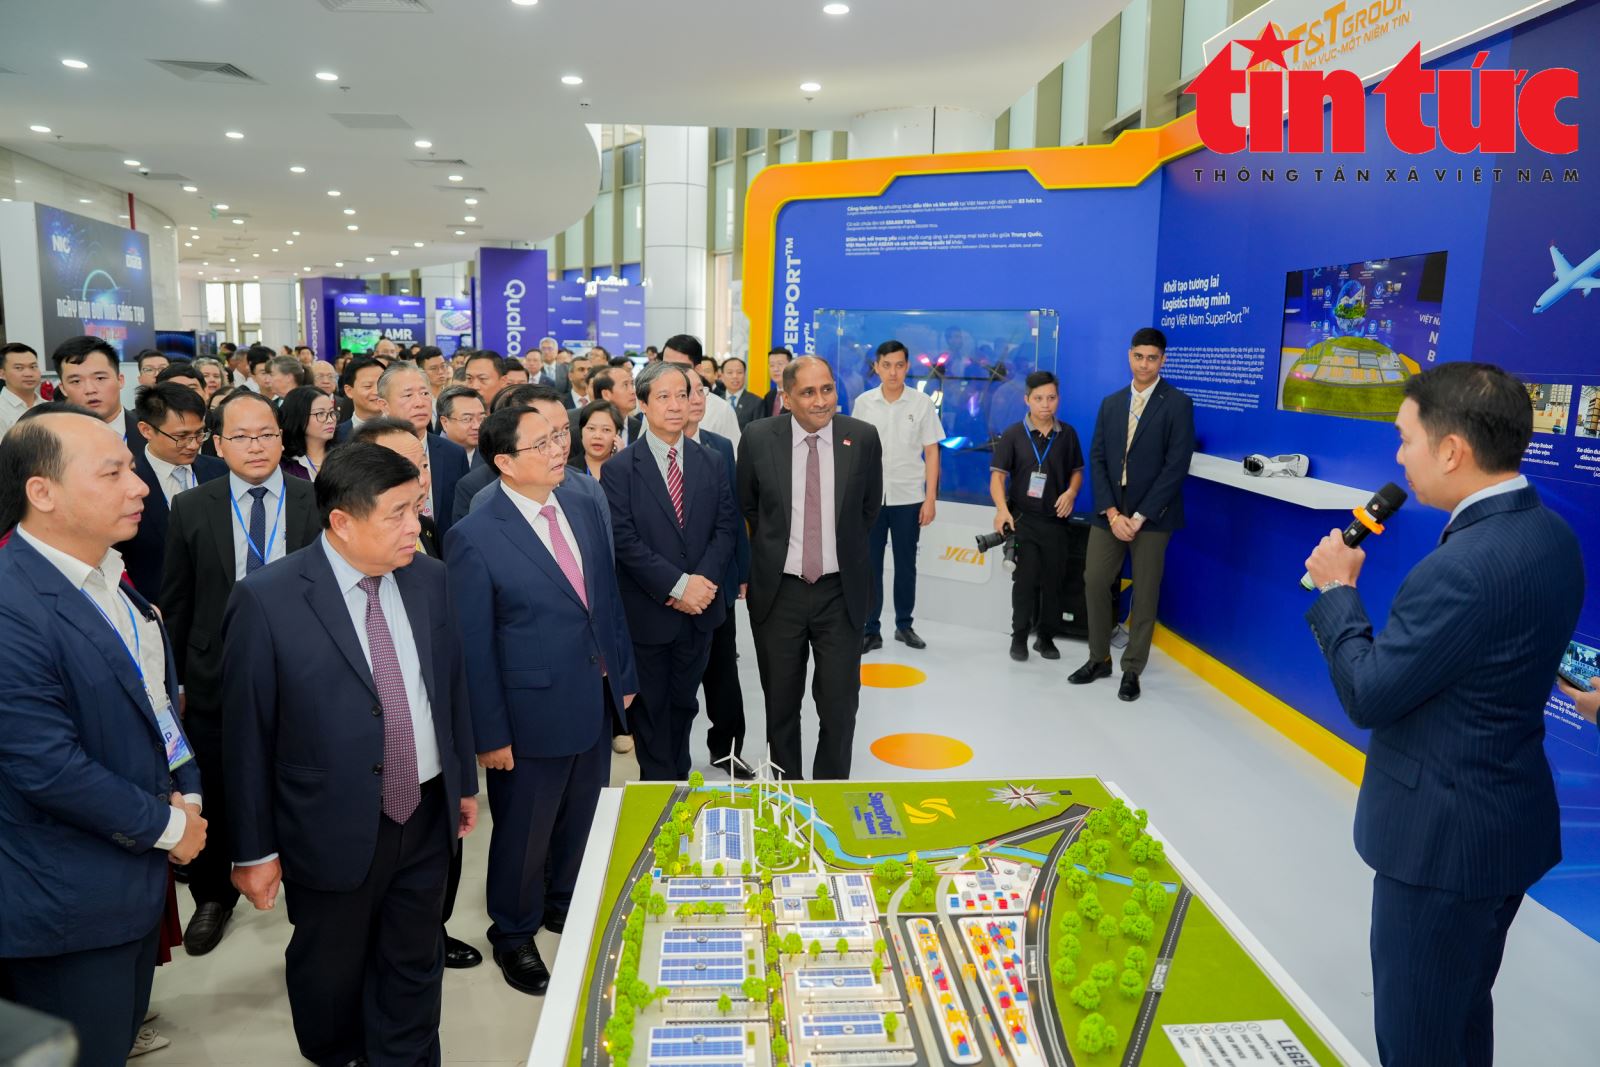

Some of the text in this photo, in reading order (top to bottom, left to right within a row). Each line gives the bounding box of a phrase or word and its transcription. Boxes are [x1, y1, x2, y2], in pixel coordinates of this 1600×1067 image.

[1342, 0, 1403, 38] GROU
[1391, 11, 1412, 31] TIN
[52, 234, 71, 254] NIC
[1177, 280, 1188, 294] tạo
[1188, 277, 1209, 293] tương
[1210, 274, 1220, 288] lai
[784, 237, 801, 358] PERPORT™
[1162, 291, 1231, 312] Logistics thông minh
[503, 279, 526, 358] Qualco
[1161, 315, 1175, 328] cùng
[1176, 314, 1188, 328] Việt
[1188, 314, 1205, 325] Nam
[310, 298, 319, 361] Qualcom
[384, 328, 413, 341] AMR
[1277, 1039, 1313, 1067] LEGE
